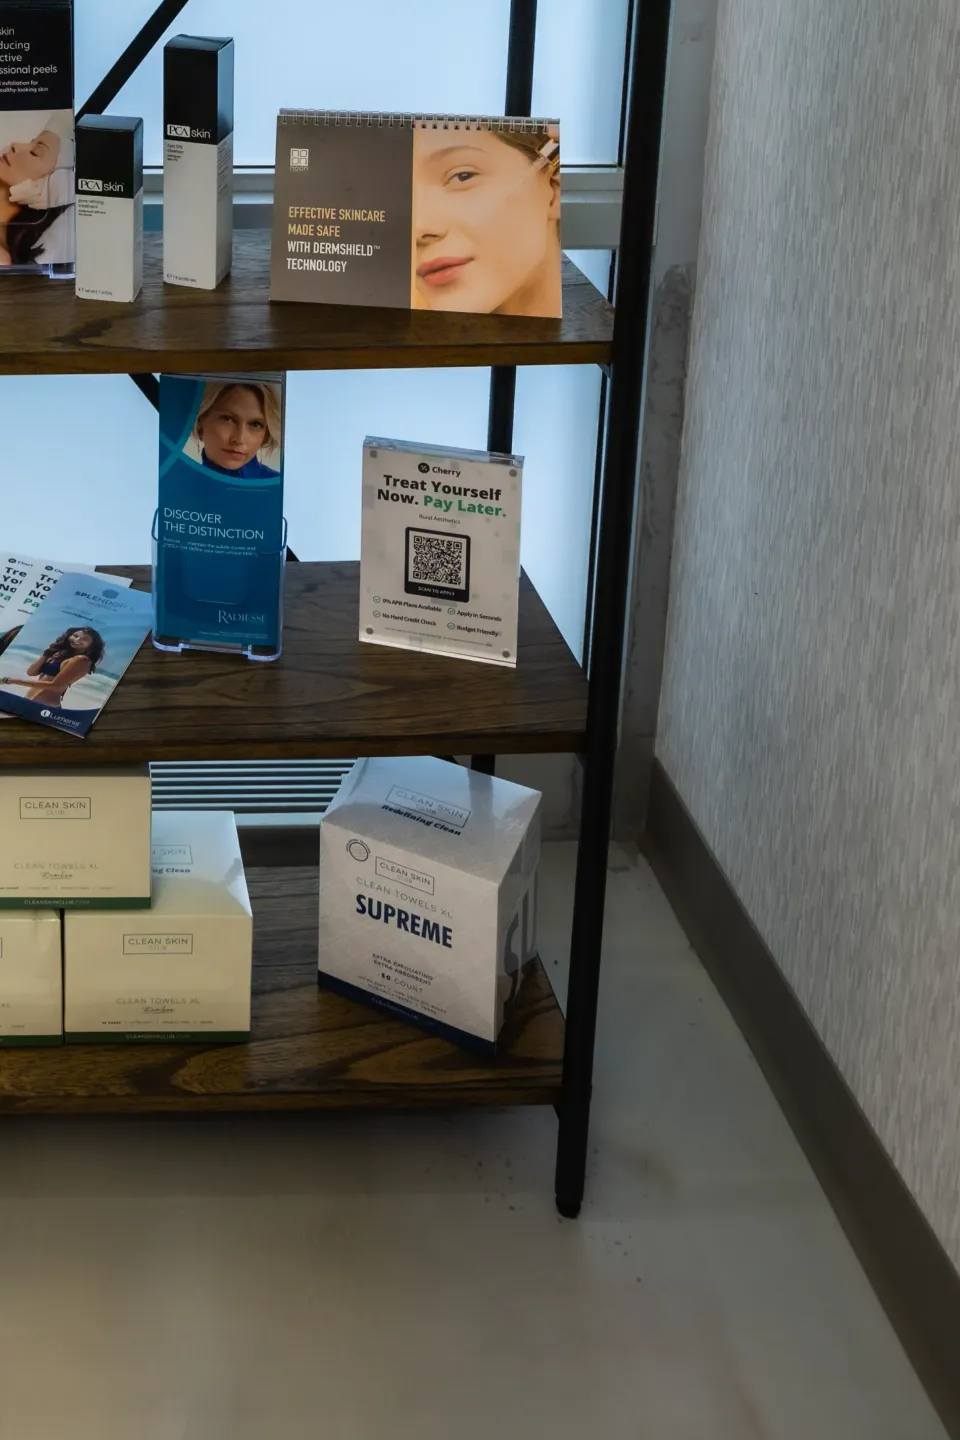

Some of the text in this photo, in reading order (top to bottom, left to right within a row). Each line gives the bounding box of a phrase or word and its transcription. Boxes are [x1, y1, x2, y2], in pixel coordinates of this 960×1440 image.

[33, 64, 58, 75] peels
[289, 206, 386, 222] EFFECTIVE SKINCARE
[288, 224, 340, 237] MADE SAFE
[287, 241, 311, 253] WITH
[287, 258, 347, 273] TECHNOLOGY
[432, 466, 461, 477] Cherry
[383, 475, 501, 500] Treat Yourself
[377, 489, 506, 518] Now. Pay Later.
[164, 508, 222, 524] DISCOVER
[434, 516, 461, 524] Aesthetics
[164, 521, 264, 540] THE DISTINCTION
[405, 615, 419, 623] Credit
[420, 618, 436, 626] Check
[457, 625, 476, 633] Budget
[477, 628, 499, 637] Friendly
[395, 790, 463, 819] CLEAN SKIN
[381, 804, 461, 836] Redefining Clean
[380, 862, 431, 886] CLEAN SKIN
[356, 877, 453, 919] CLEAN TOWELS XL
[356, 894, 452, 948] SUPREME
